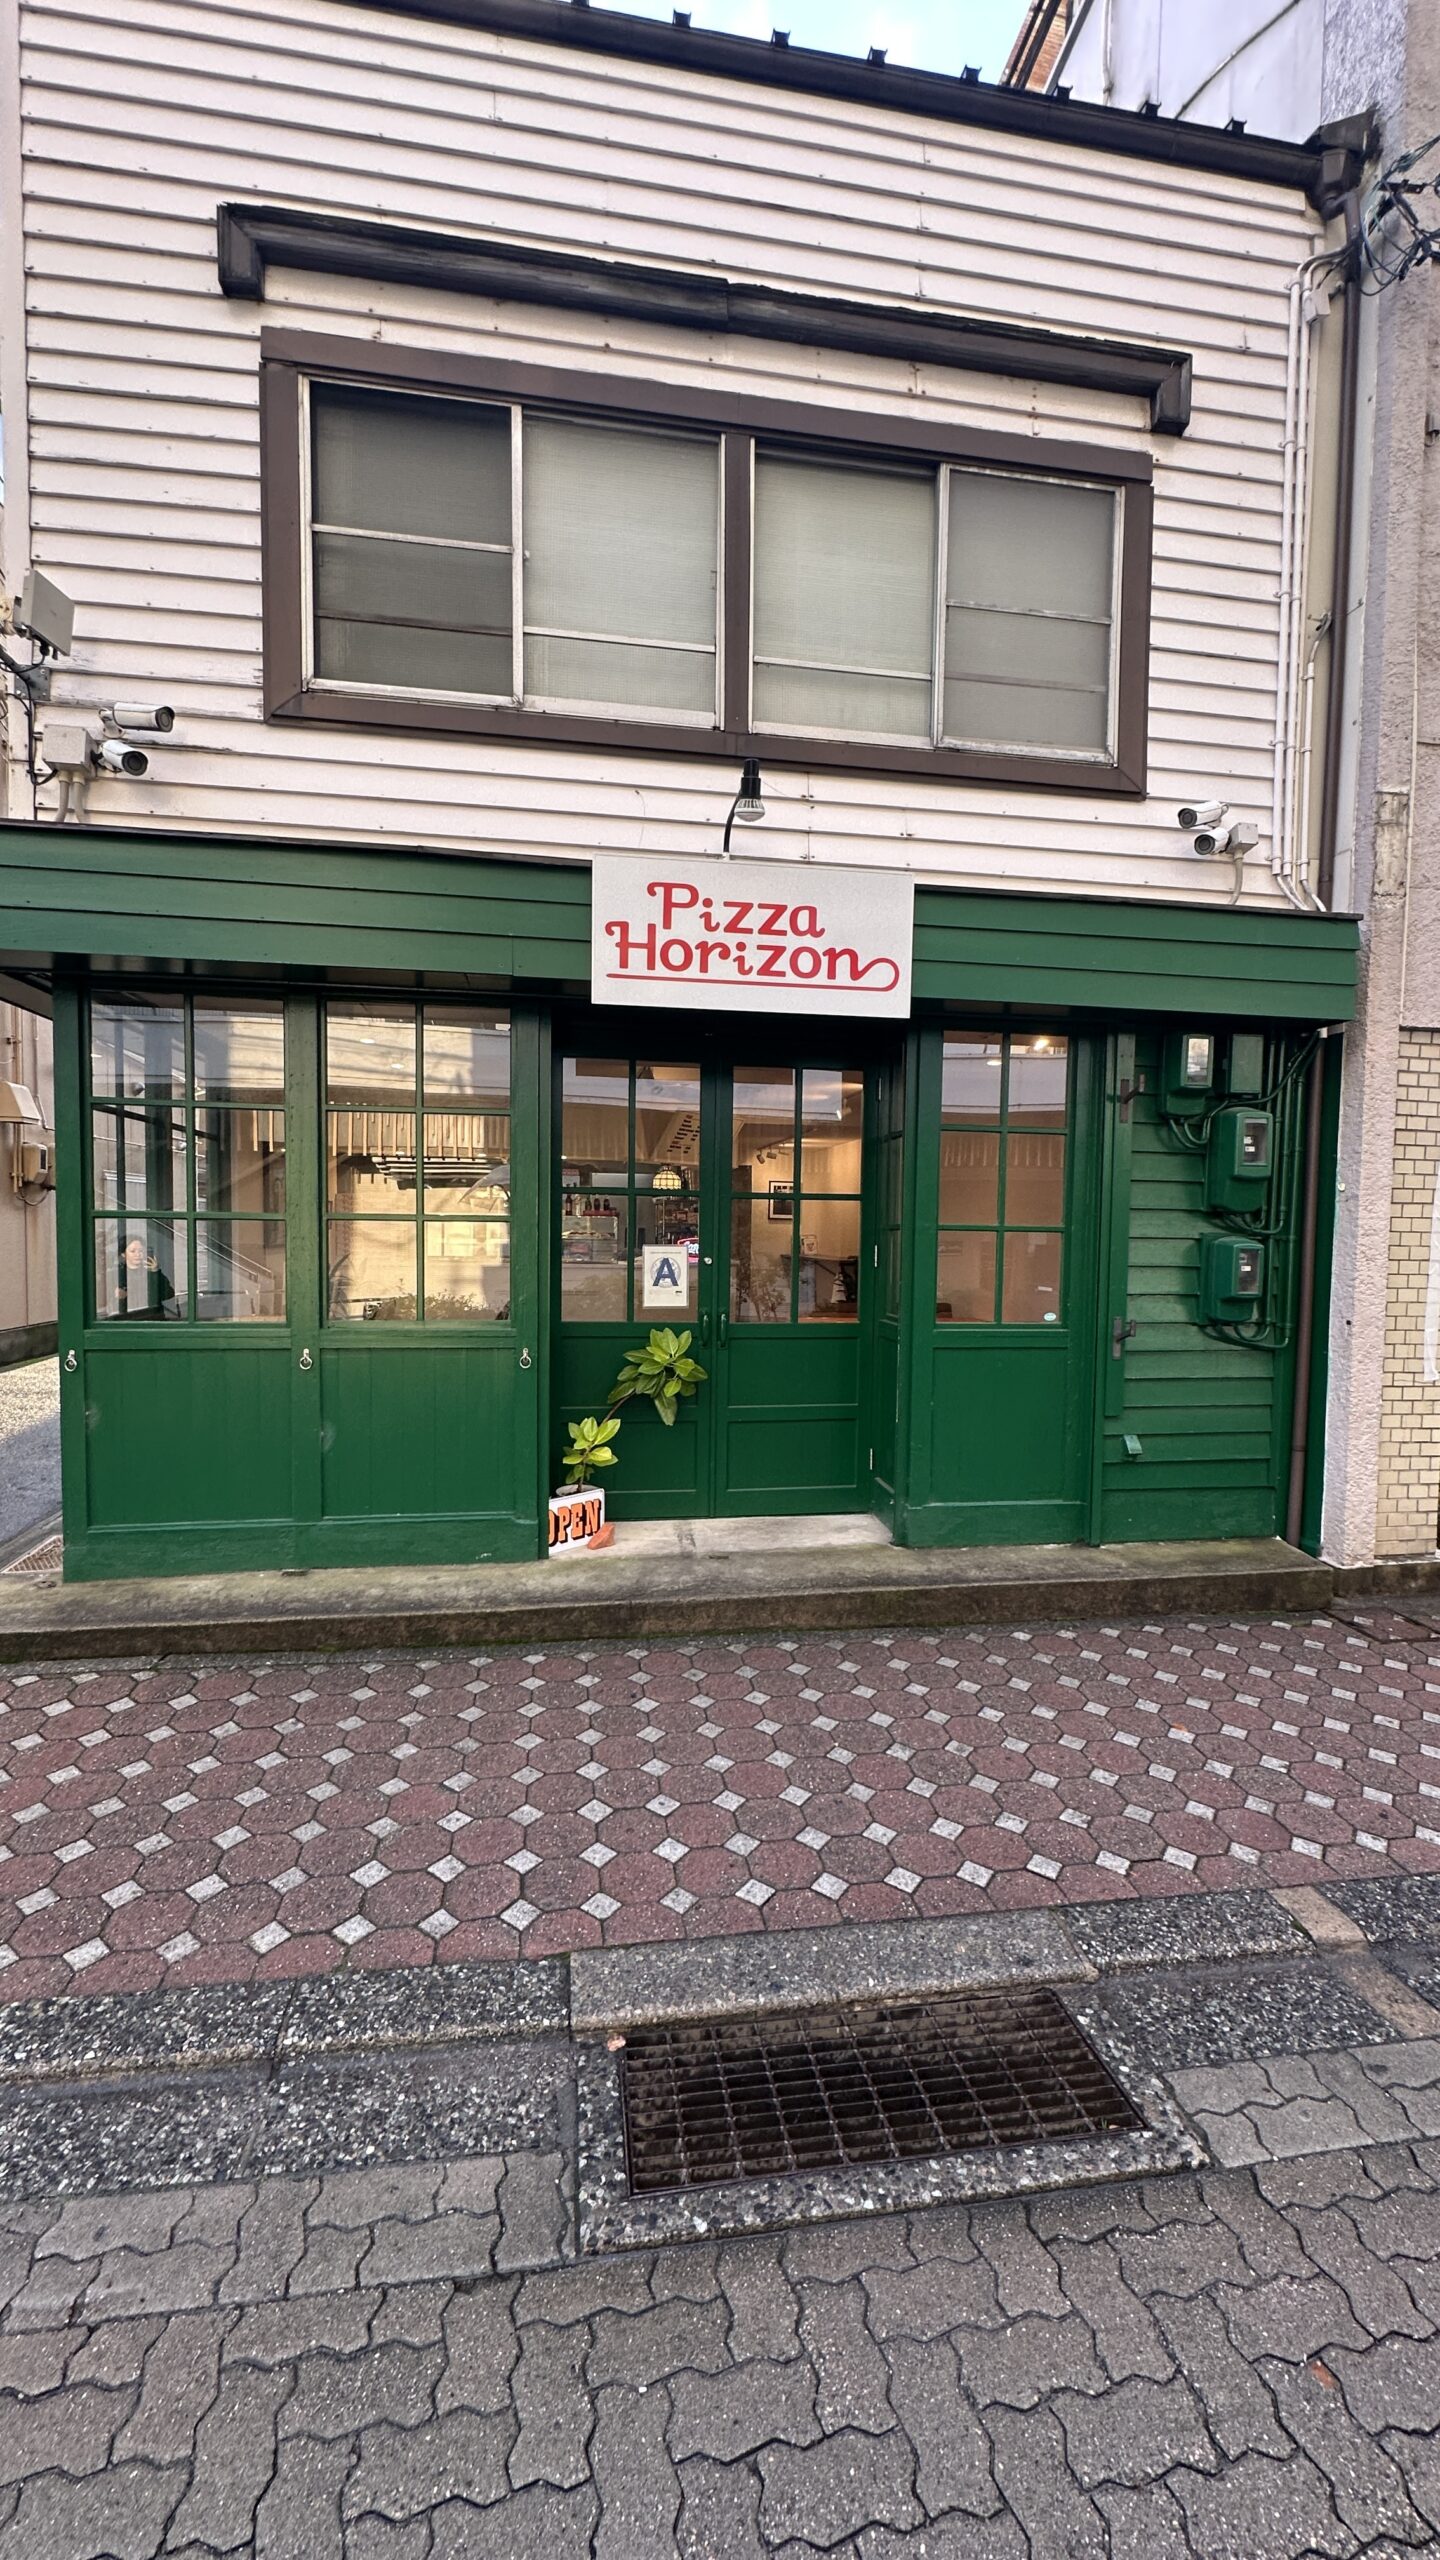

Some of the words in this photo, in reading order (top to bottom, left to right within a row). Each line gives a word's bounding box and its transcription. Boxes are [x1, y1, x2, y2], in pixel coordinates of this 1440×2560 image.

[647, 882, 825, 938] Pizza
[605, 920, 900, 992] Horizon
[653, 1257, 679, 1287] A
